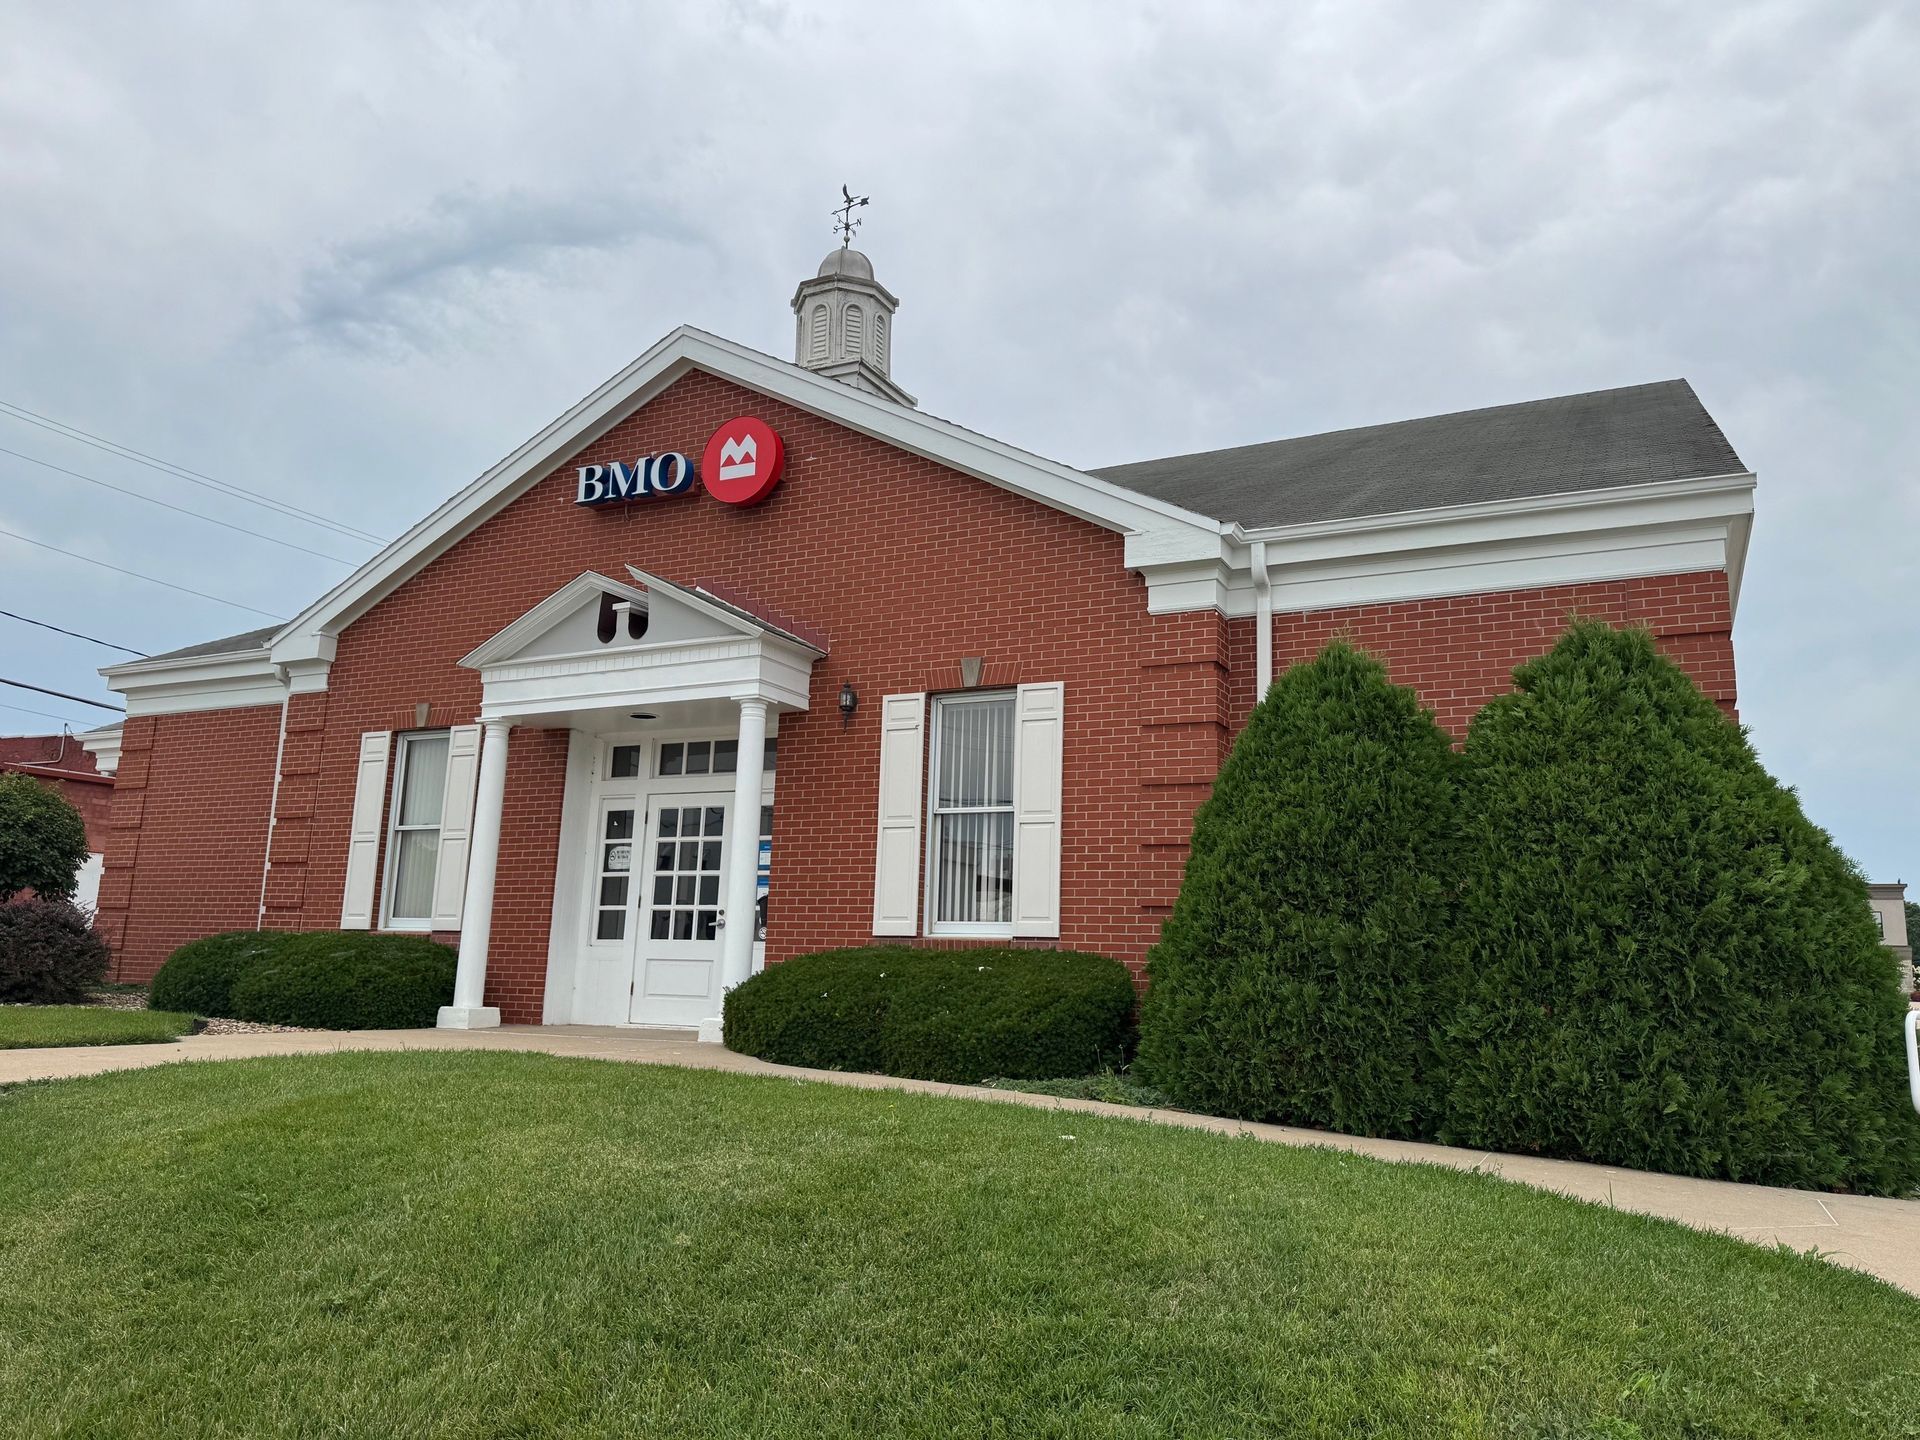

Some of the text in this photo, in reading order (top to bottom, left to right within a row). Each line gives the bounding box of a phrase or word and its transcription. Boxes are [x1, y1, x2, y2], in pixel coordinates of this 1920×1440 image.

[856, 217, 862, 227] N
[833, 225, 838, 234] S
[574, 451, 691, 504] BMO
